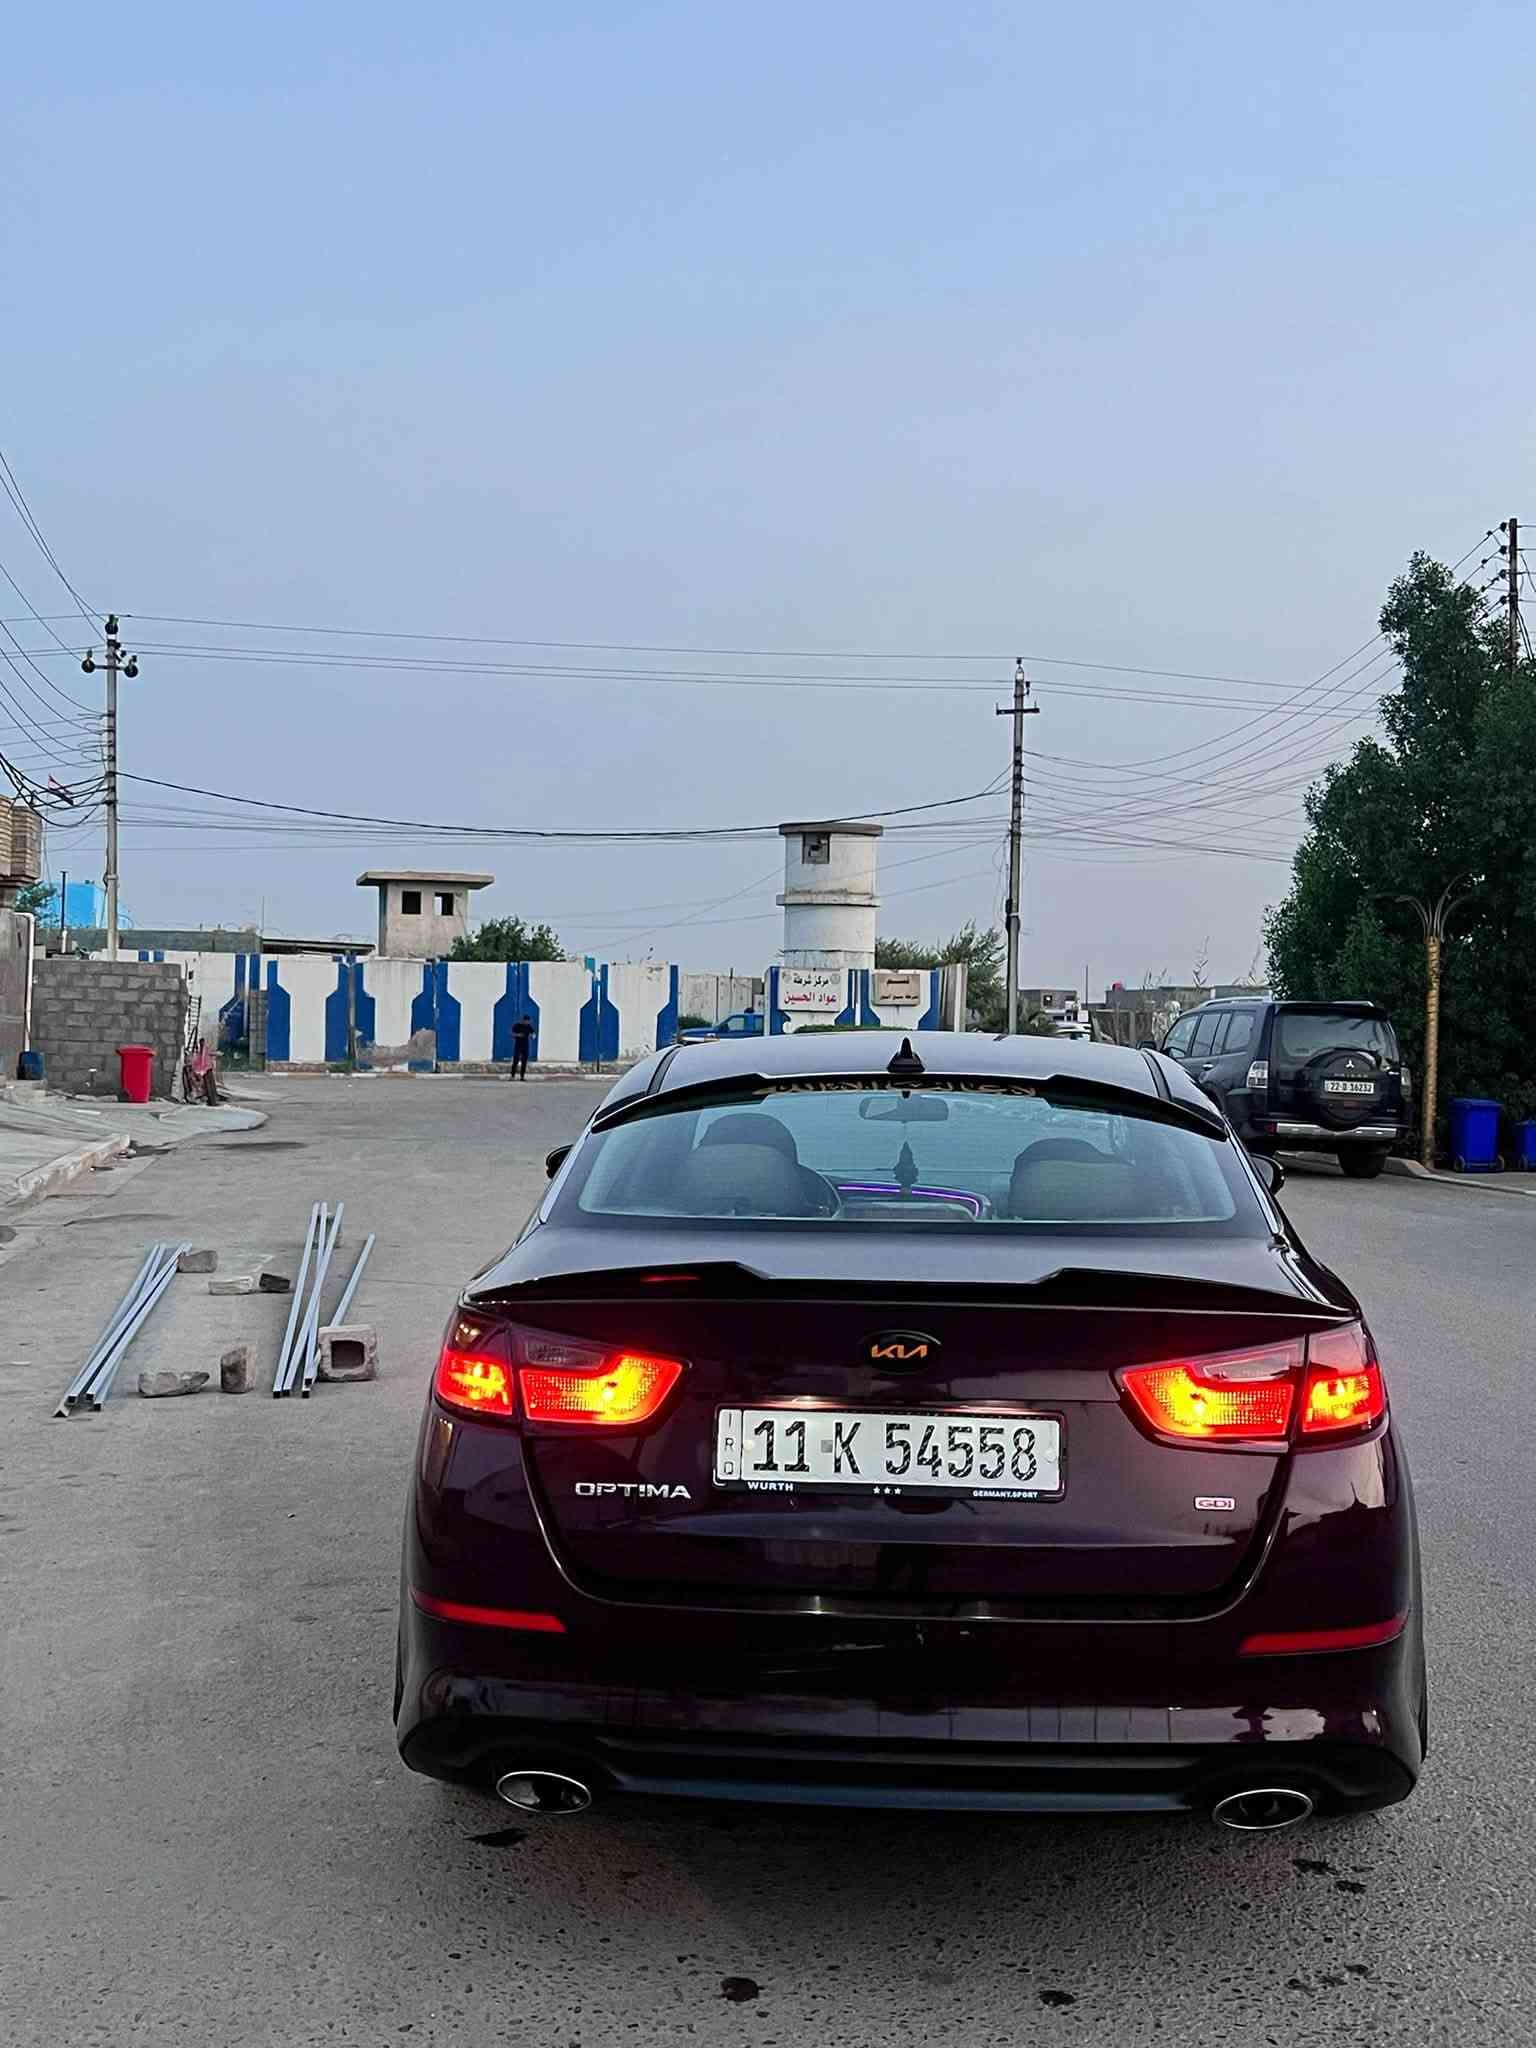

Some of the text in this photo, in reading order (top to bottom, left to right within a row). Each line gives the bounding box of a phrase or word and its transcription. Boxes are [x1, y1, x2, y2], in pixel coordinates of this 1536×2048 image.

[812, 975, 829, 987] مركز
[784, 991, 837, 1005] عواد الحسين
[872, 1344, 928, 1358] KIA
[753, 1420, 1037, 1481] 11 K 54558
[575, 1483, 691, 1499] OPTIMA
[747, 1481, 794, 1491] WURTH
